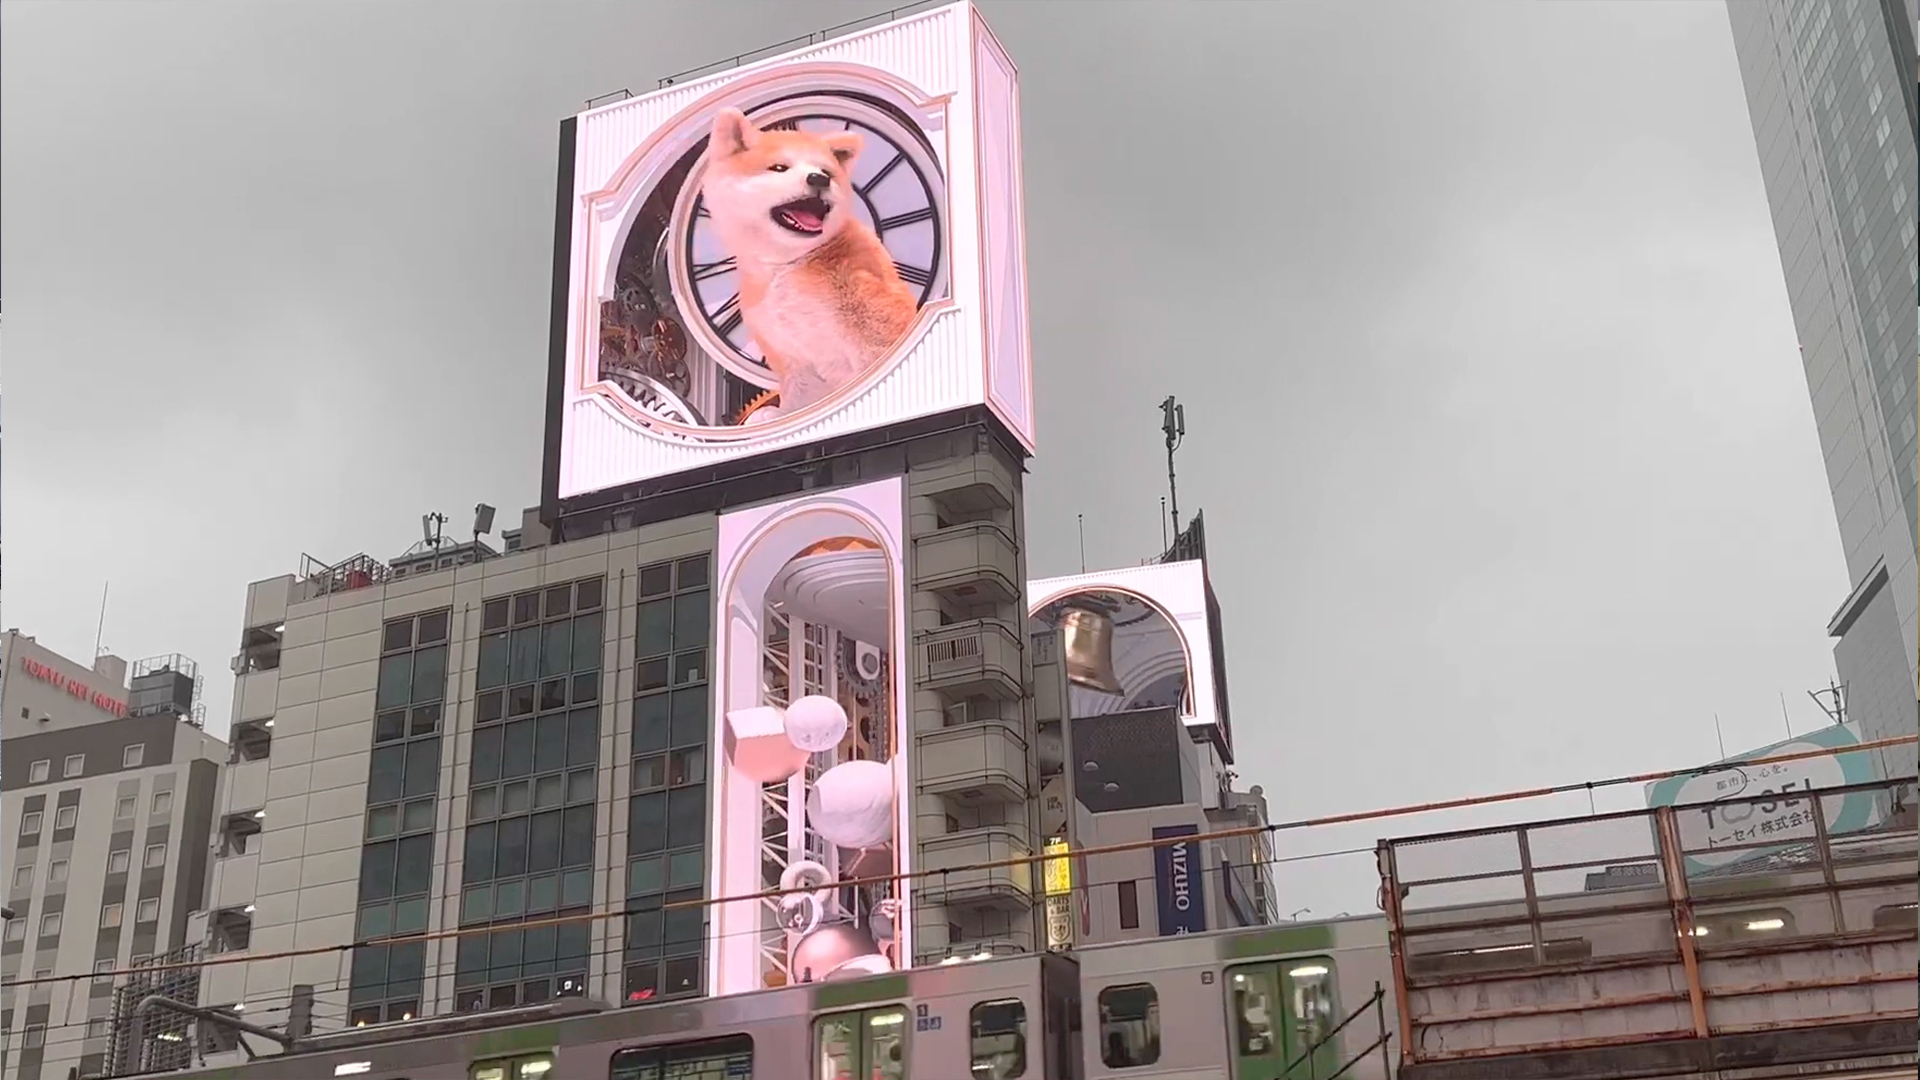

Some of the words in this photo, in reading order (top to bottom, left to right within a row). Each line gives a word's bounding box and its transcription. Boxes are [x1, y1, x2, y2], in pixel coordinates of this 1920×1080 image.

[21, 656, 65, 686] TOKYU
[91, 690, 128, 718] HOTE
[1048, 896, 1070, 906] DARTS
[1172, 841, 1190, 911] MIZUHO
